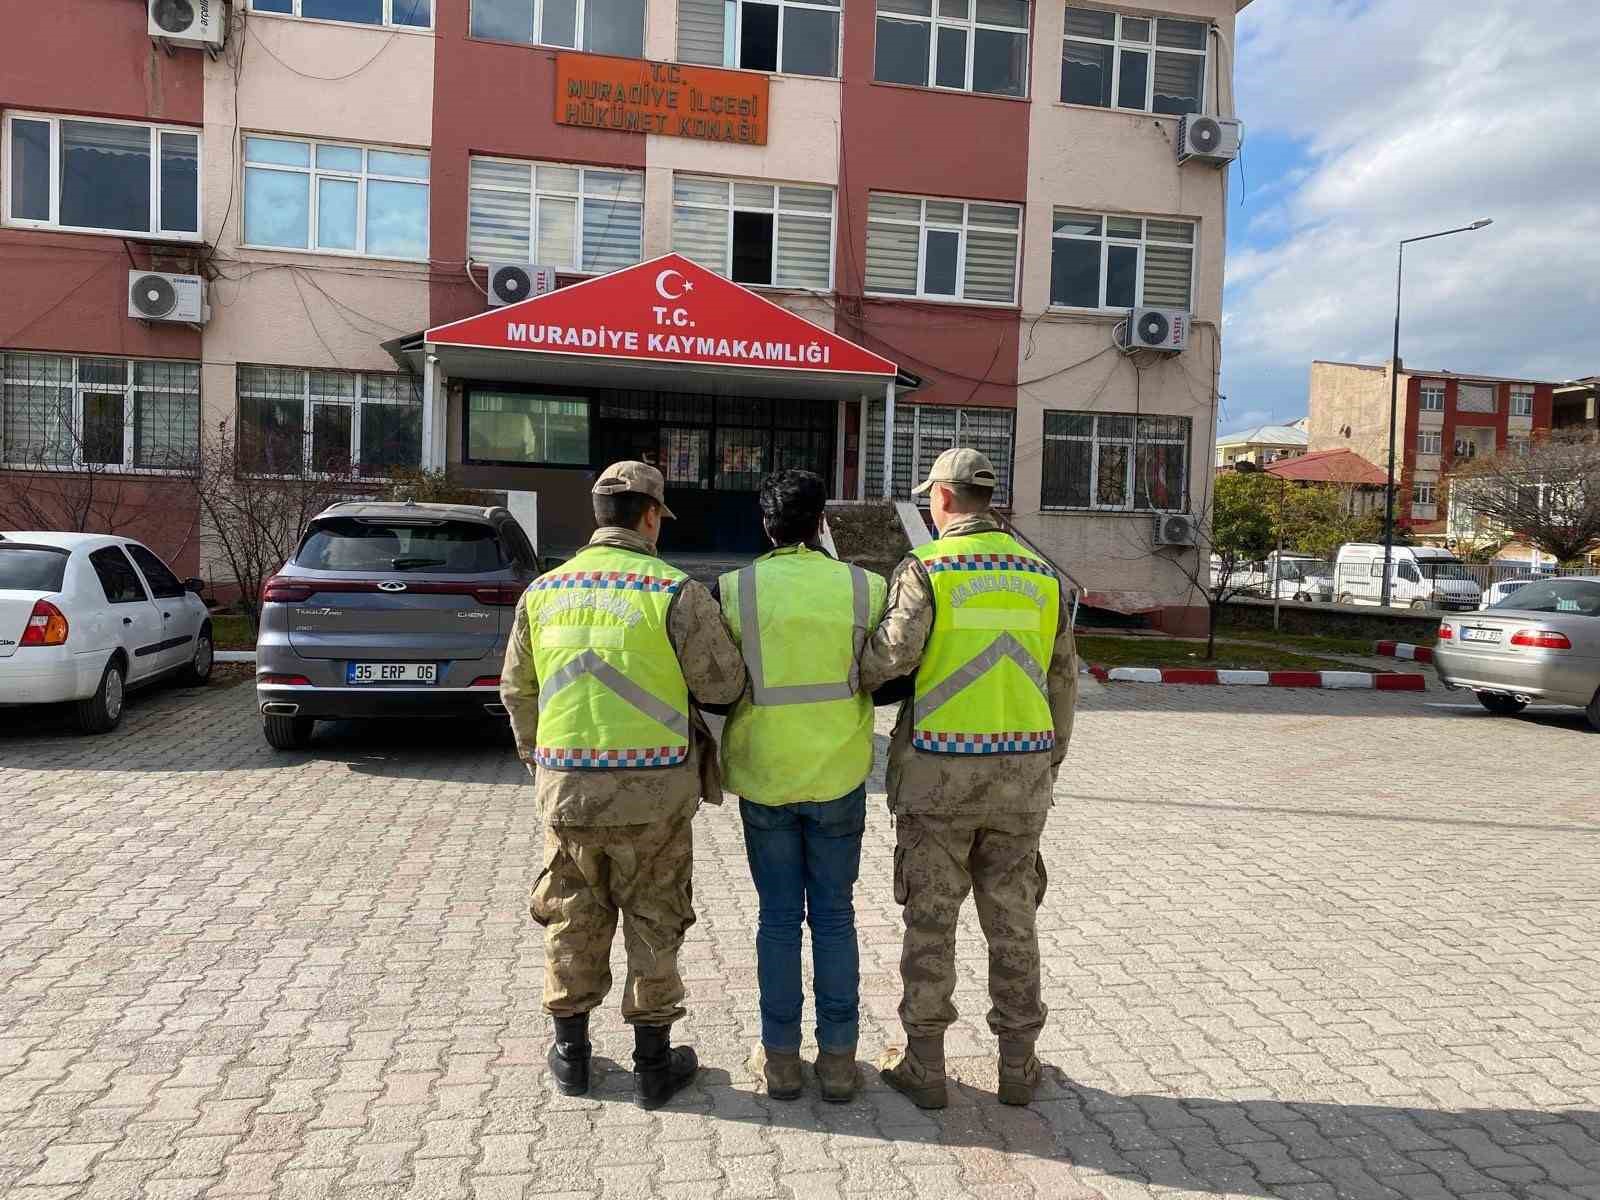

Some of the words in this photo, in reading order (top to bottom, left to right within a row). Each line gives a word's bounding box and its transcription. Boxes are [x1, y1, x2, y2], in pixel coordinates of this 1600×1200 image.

[651, 64, 688, 85] T.C.
[567, 78, 680, 109] MURADİYE
[689, 87, 758, 118] İLÇESİ
[566, 103, 667, 131] HÜKÜMET
[679, 116, 757, 143] KONAĞI
[653, 306, 696, 328] T.C.
[507, 322, 639, 350] MURADİYE
[647, 333, 830, 363] KAYMAKAMLIĞI
[952, 575, 1048, 608] JANDARMA
[356, 665, 372, 679] 35
[381, 665, 406, 679] ERP
[417, 665, 433, 679] 06
